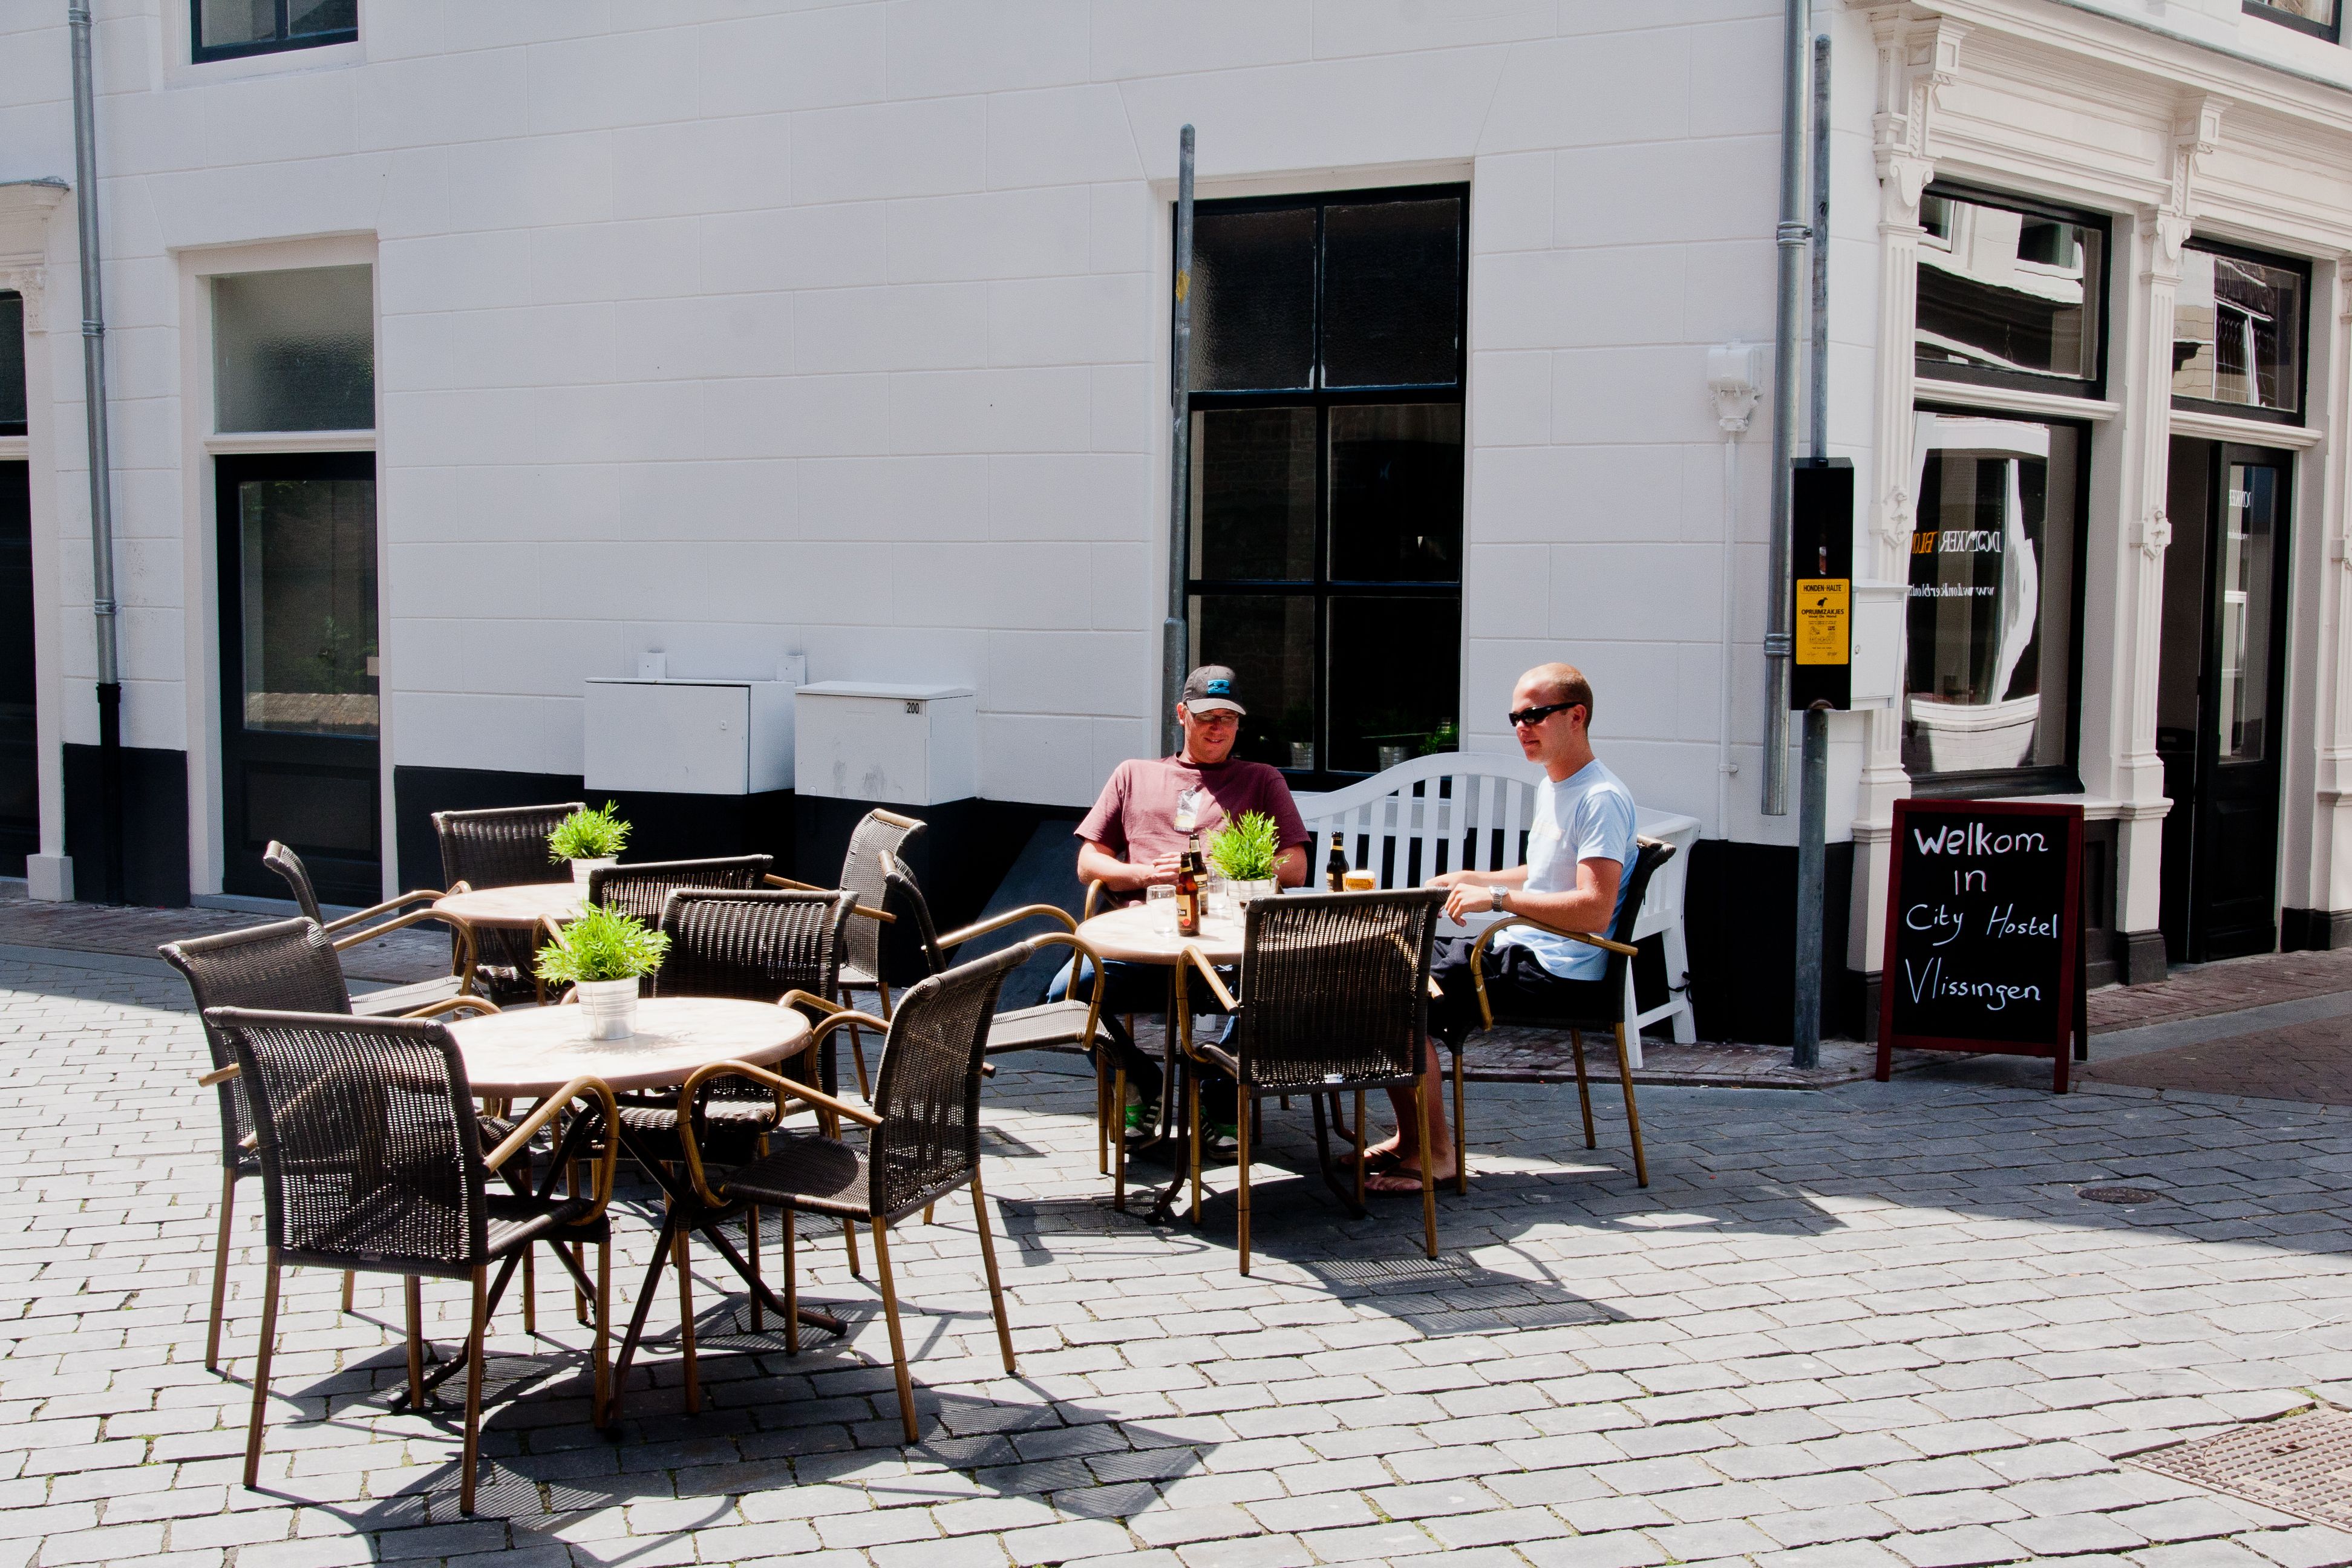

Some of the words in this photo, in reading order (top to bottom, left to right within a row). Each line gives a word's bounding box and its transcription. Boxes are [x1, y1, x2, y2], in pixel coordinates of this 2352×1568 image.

[907, 702, 920, 714] 200
[1913, 822, 2048, 855] Welkom
[1906, 904, 1964, 946] City
[1986, 903, 2058, 938] Hostel
[1905, 957, 2041, 1011] Vlissingen
